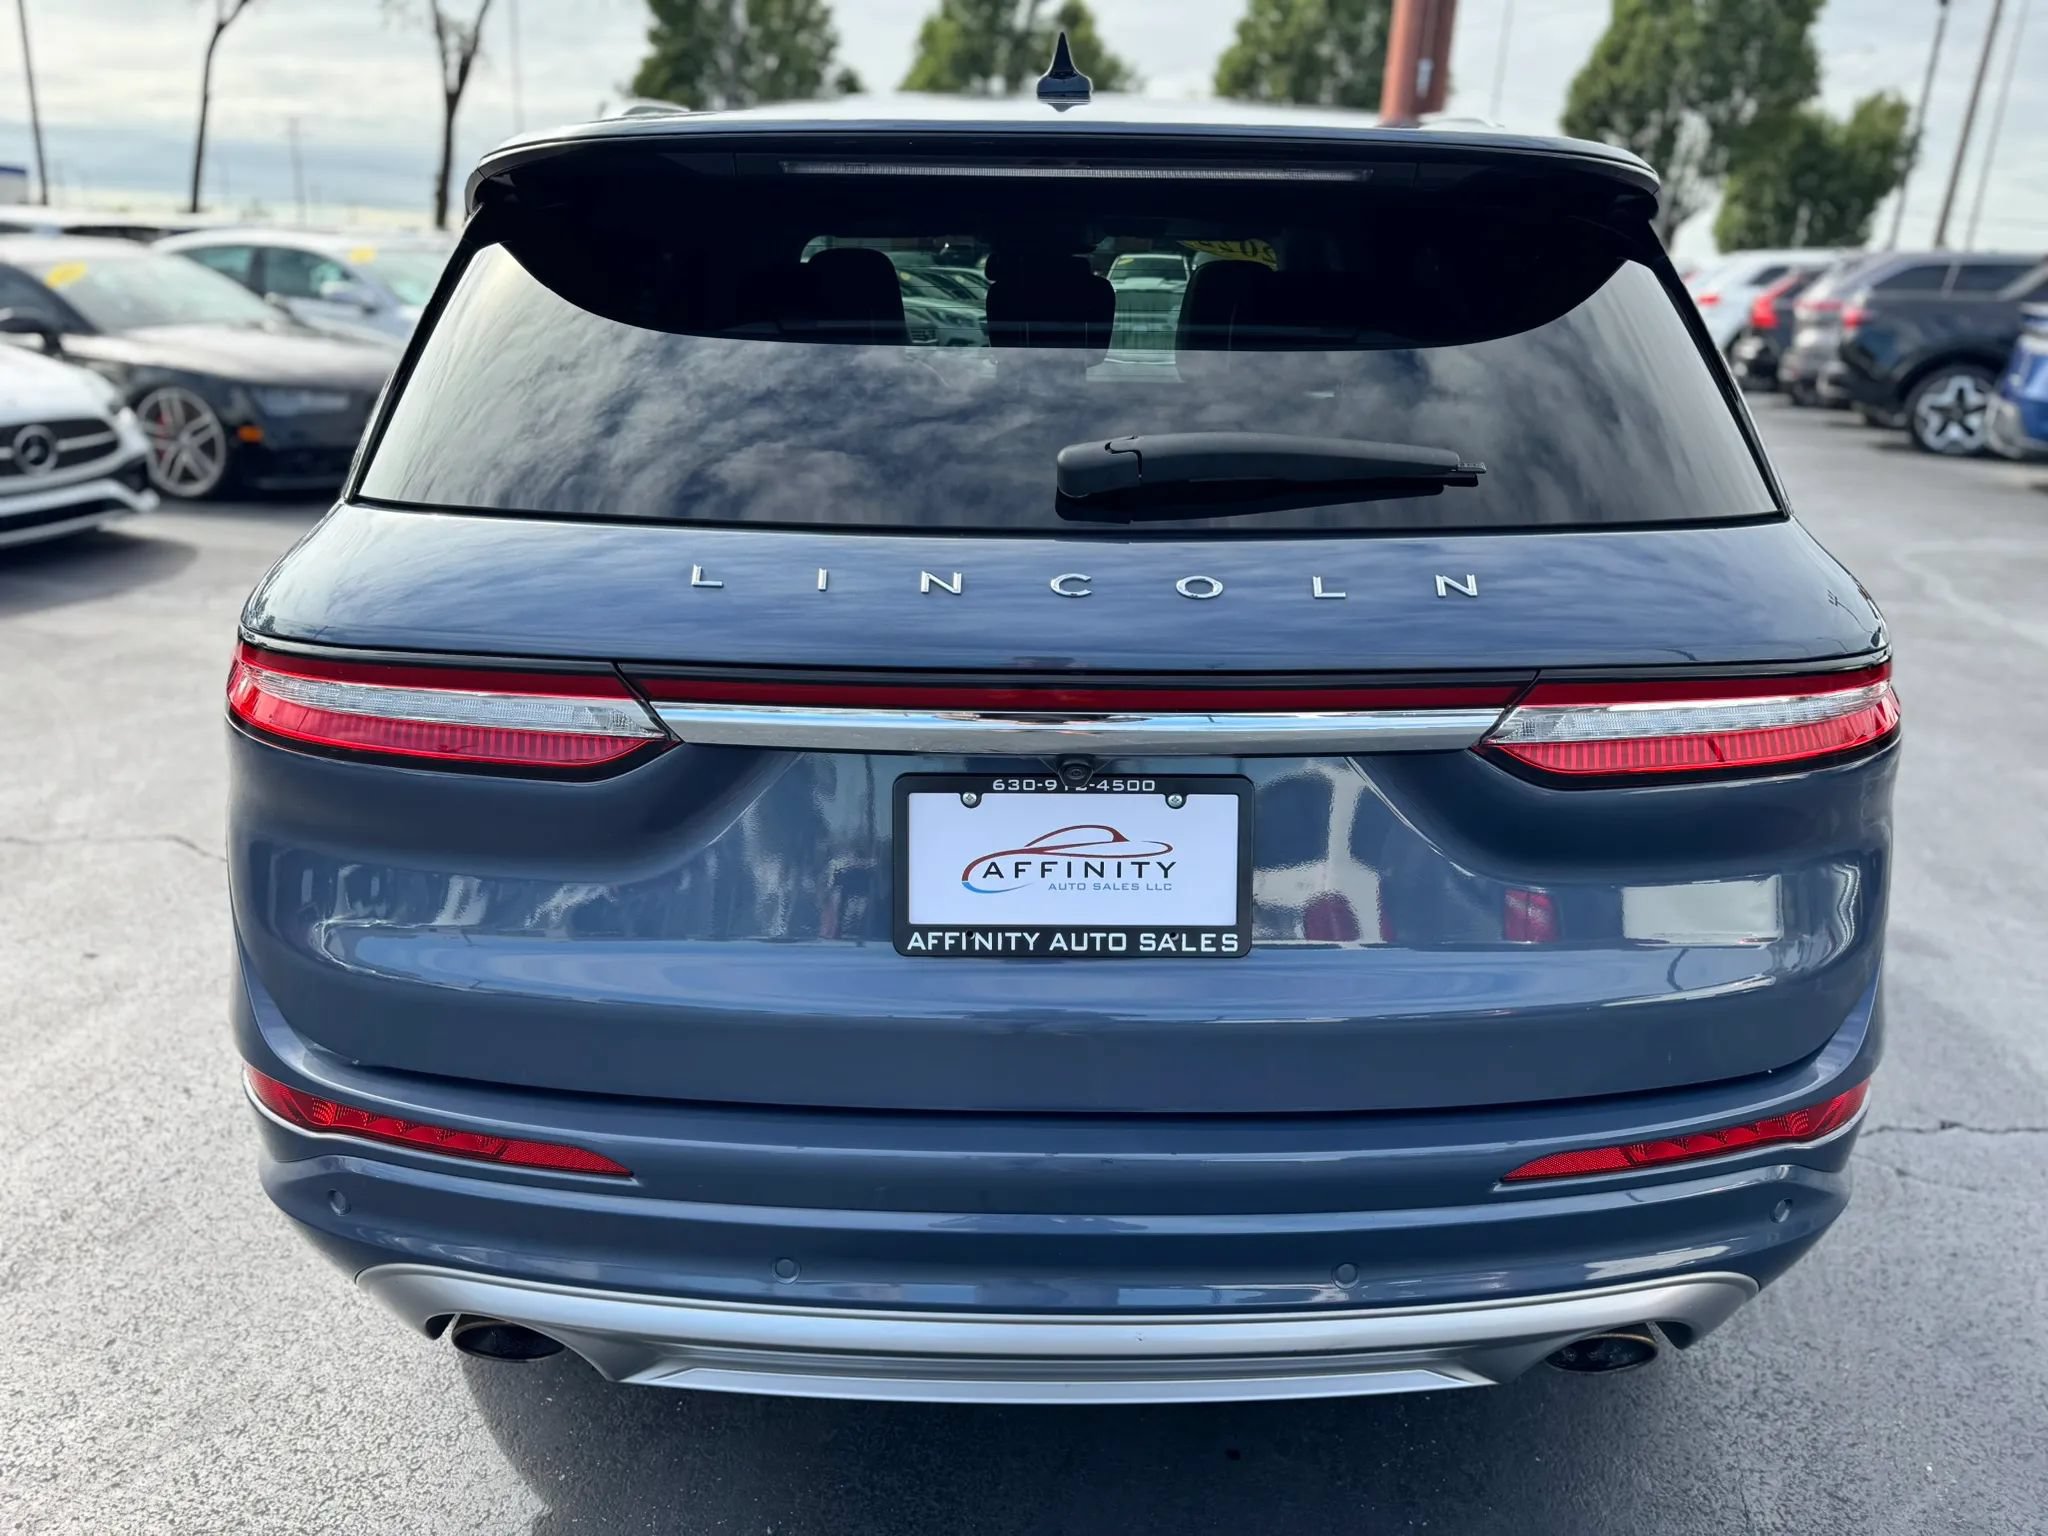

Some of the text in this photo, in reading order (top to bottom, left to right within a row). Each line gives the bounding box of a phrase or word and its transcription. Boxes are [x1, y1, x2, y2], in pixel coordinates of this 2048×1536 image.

[691, 563, 1479, 600] LINCOLN
[991, 777, 1157, 793] 630-9-4500
[981, 860, 1177, 879] AFFINITY
[1048, 882, 1172, 891] AUTO SALES LLC
[906, 931, 1239, 953] AFFINITY AUTO SALES
